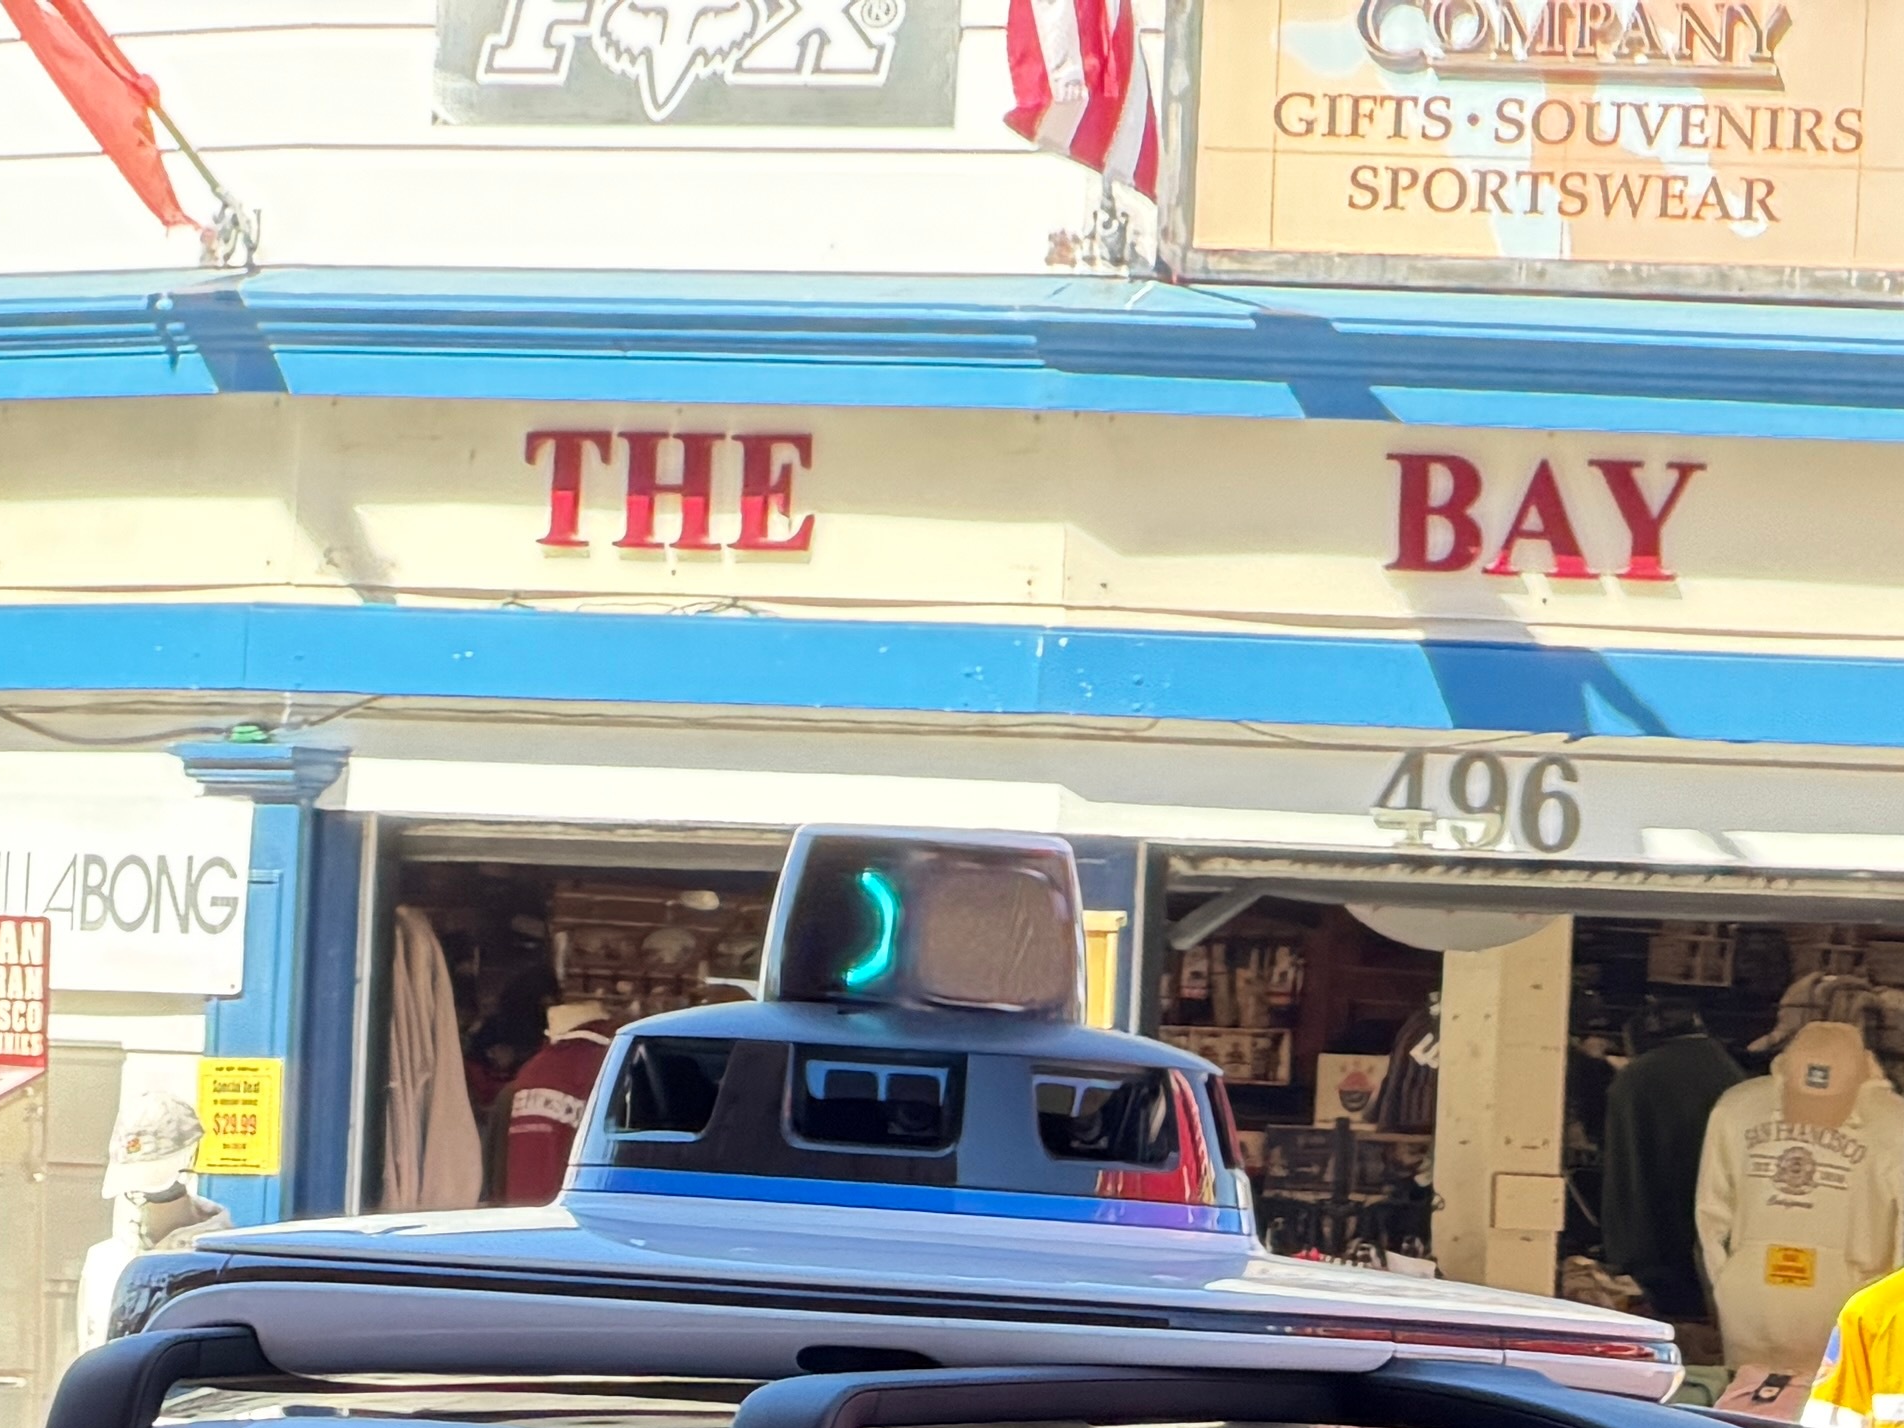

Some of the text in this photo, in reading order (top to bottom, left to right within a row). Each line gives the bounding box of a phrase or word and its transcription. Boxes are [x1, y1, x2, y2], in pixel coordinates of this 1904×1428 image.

[1273, 92, 1865, 153] GIFTS SOUVENIRS
[1347, 164, 1783, 223] SPORTSWEAR
[524, 430, 816, 552] THE
[1383, 452, 1707, 582] BAY
[1372, 750, 1583, 855] 496
